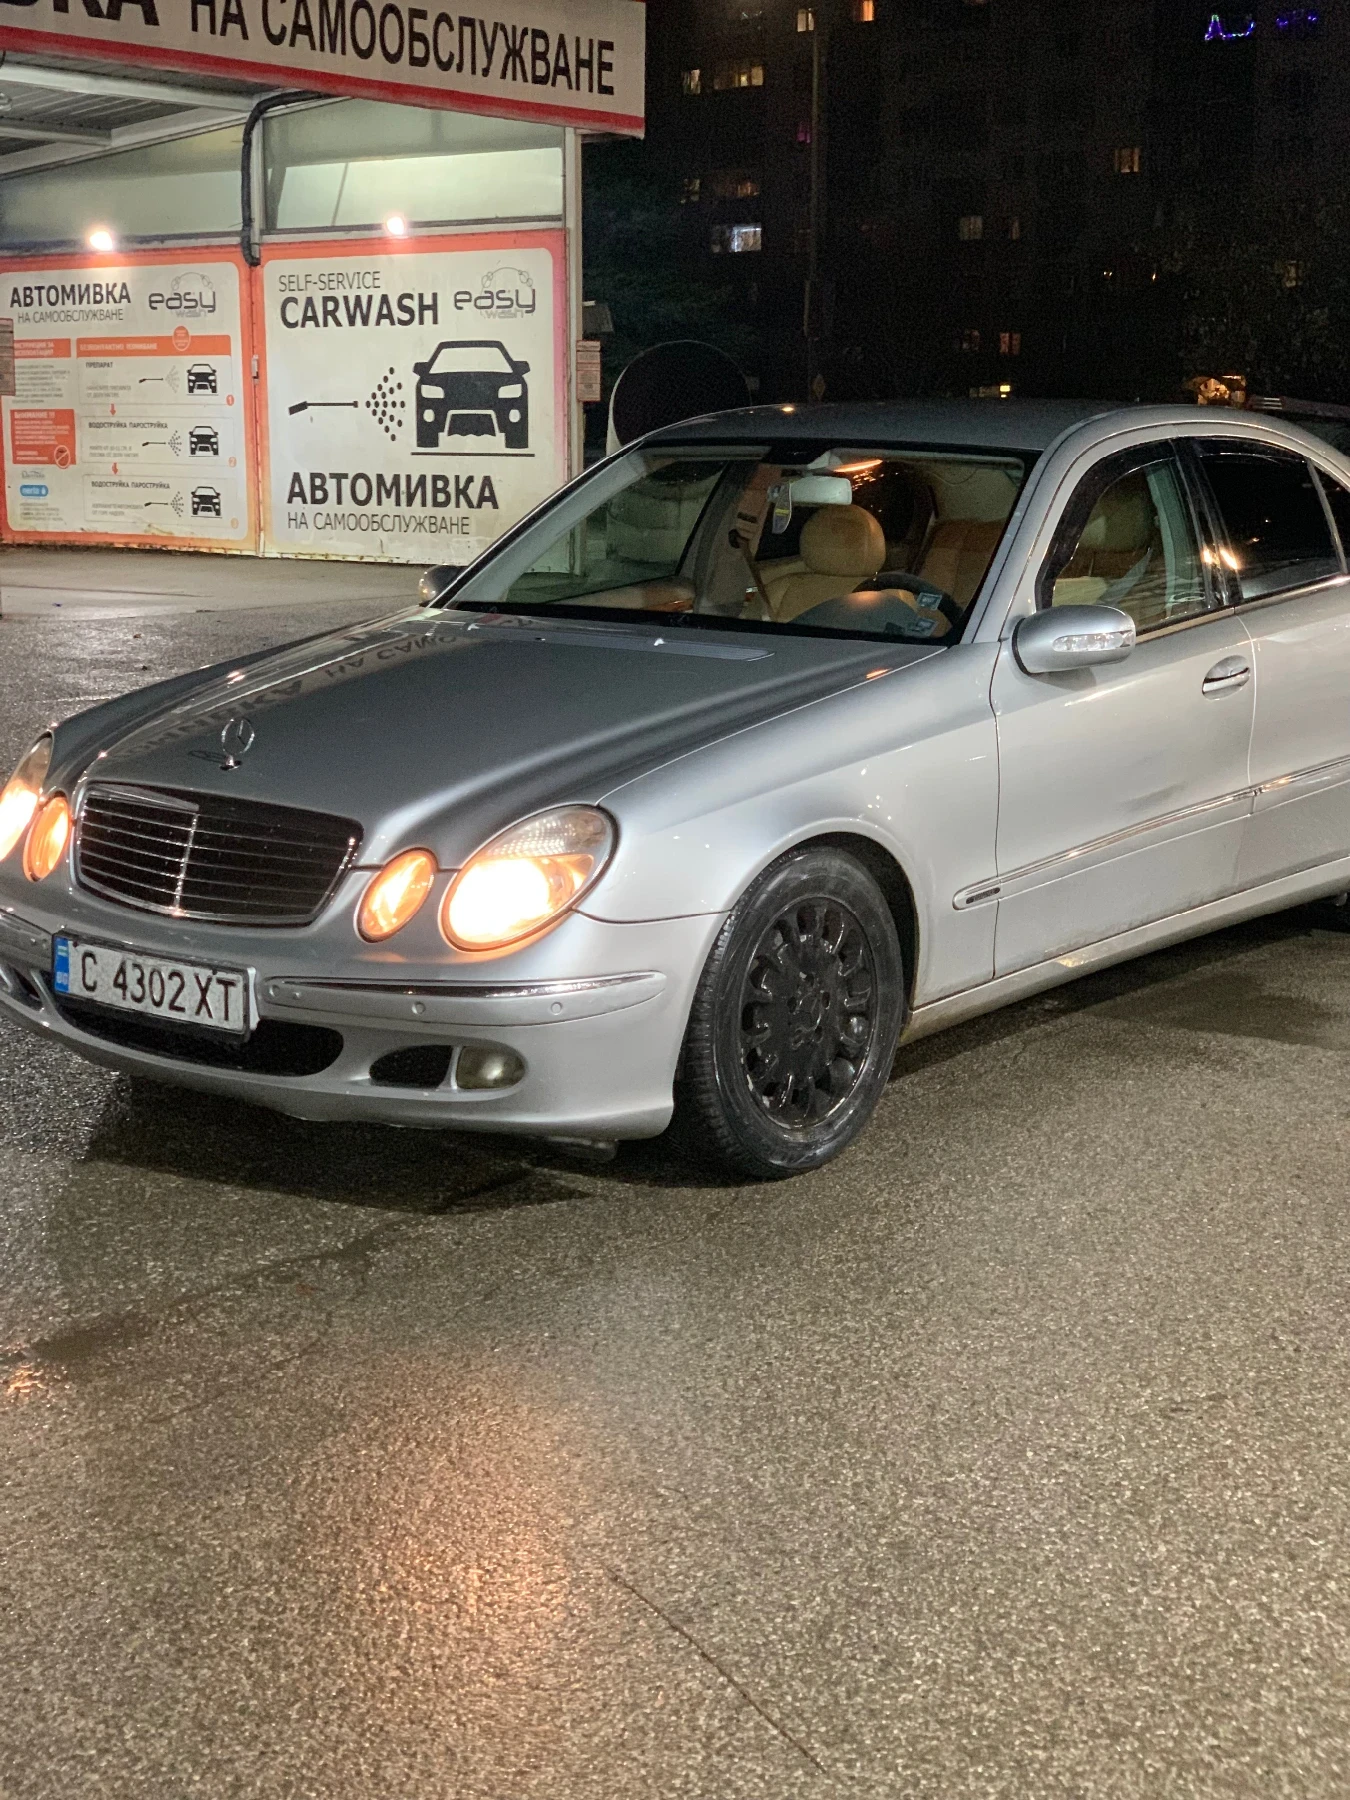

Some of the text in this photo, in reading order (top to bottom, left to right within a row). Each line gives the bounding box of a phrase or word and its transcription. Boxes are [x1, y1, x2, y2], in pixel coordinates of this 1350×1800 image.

[261, 0, 615, 96] САМООБСЛУЖВАНЕ
[279, 271, 381, 292] SELF-SERVICE
[10, 282, 131, 308] АВТОМИВКА
[148, 291, 216, 313] easy
[454, 289, 536, 314] easy
[18, 308, 124, 324] НА САМООБСЛУЖВАНЕ
[280, 292, 439, 329] CARWASH
[86, 361, 113, 369] ПРЕПАРАТ
[287, 472, 499, 509] АВТОМИВКА
[288, 512, 470, 535] НА САМООБСЛУЖВАНЕ
[81, 951, 238, 1022] C 4302 XT
